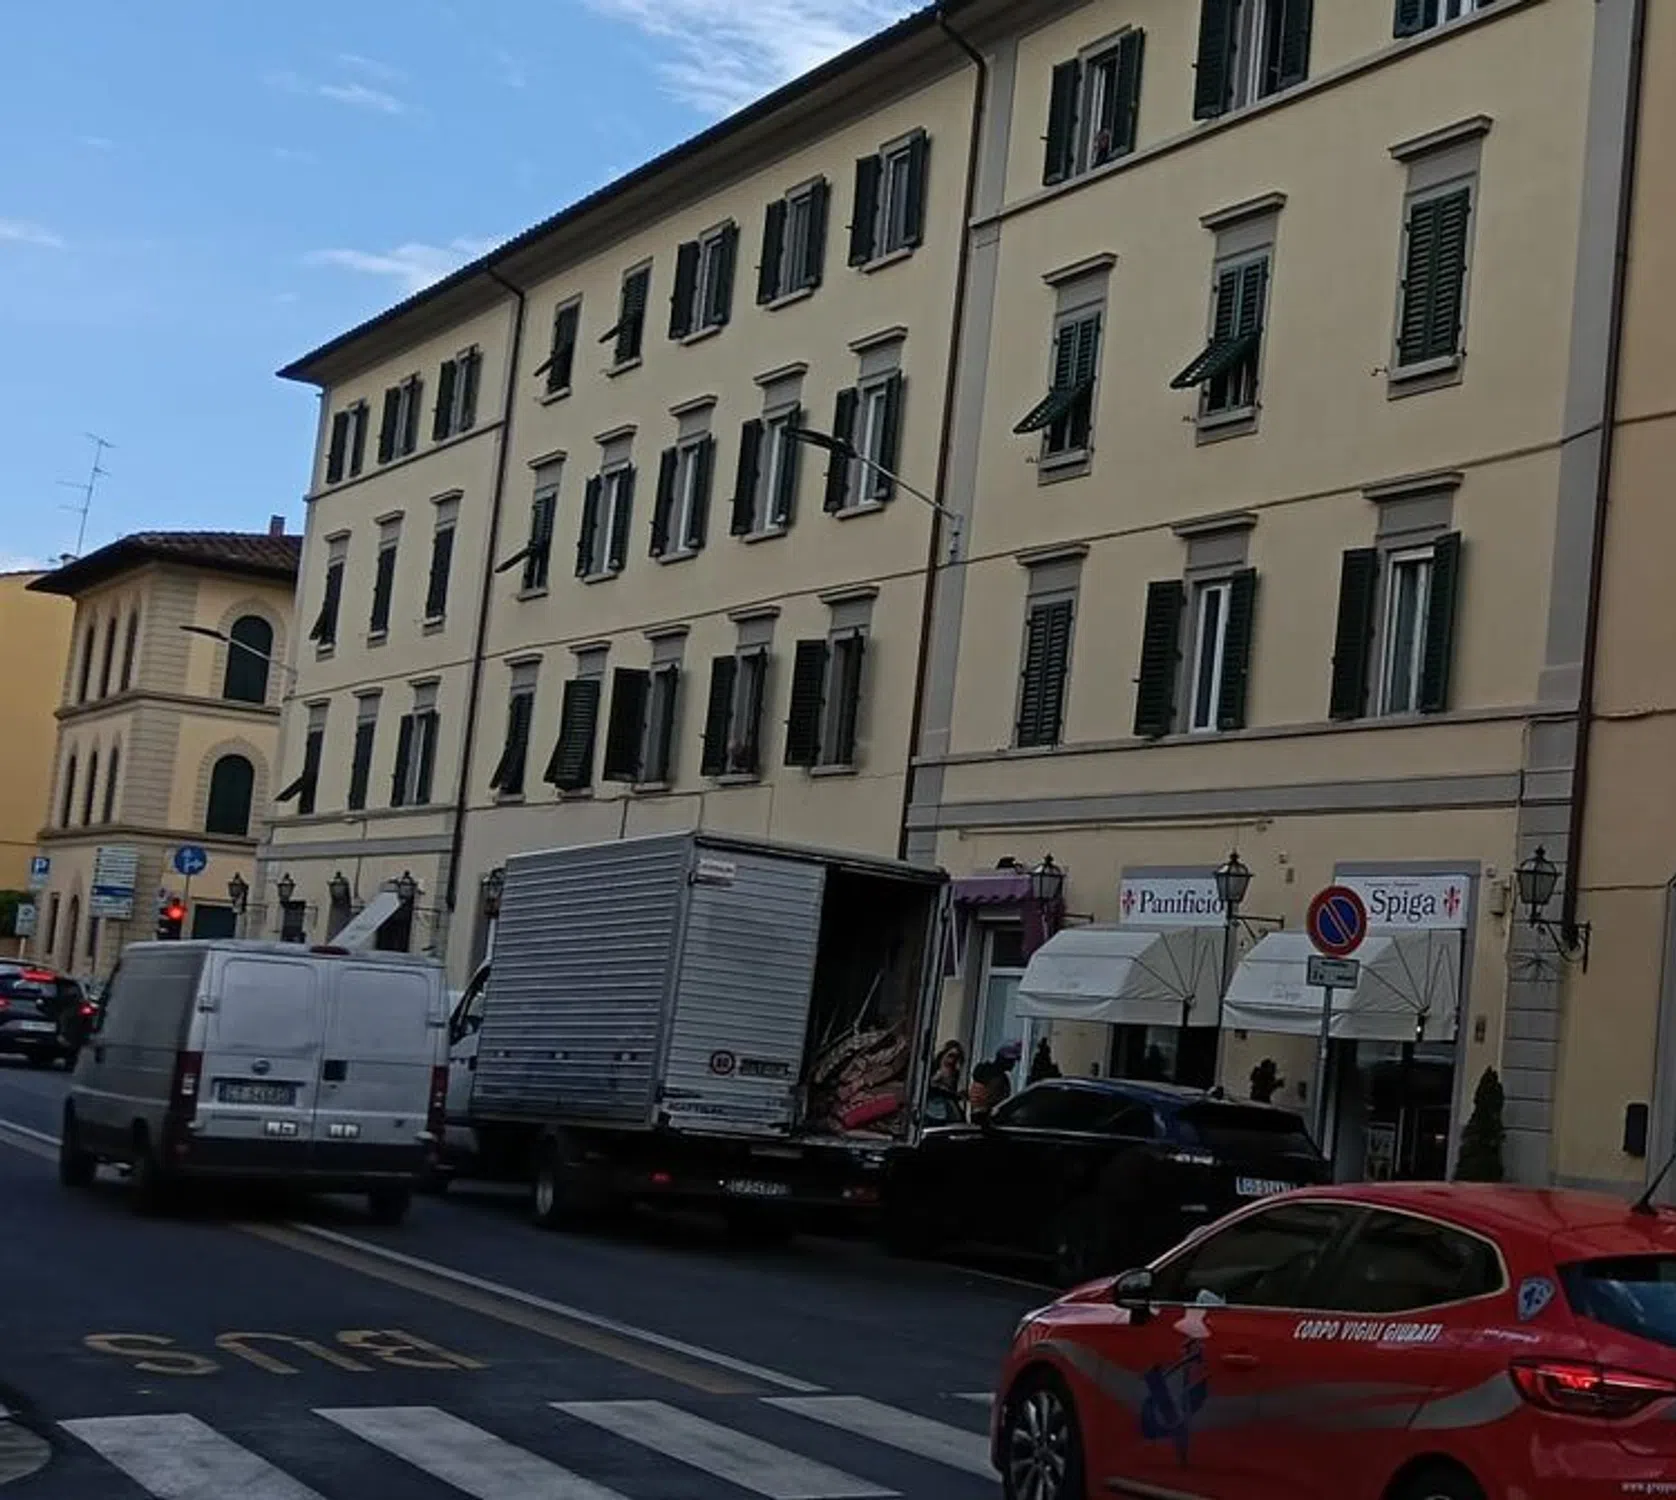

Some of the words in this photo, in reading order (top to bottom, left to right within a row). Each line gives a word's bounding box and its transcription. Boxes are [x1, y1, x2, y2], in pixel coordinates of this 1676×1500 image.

[1139, 889, 1224, 914] Panificio
[1370, 888, 1436, 922] Spiga
[1293, 1319, 1341, 1340] CORPO
[1341, 1321, 1384, 1341] VIGILI
[1382, 1323, 1444, 1342] GIURATI
[84, 1329, 490, 1376] BUS
